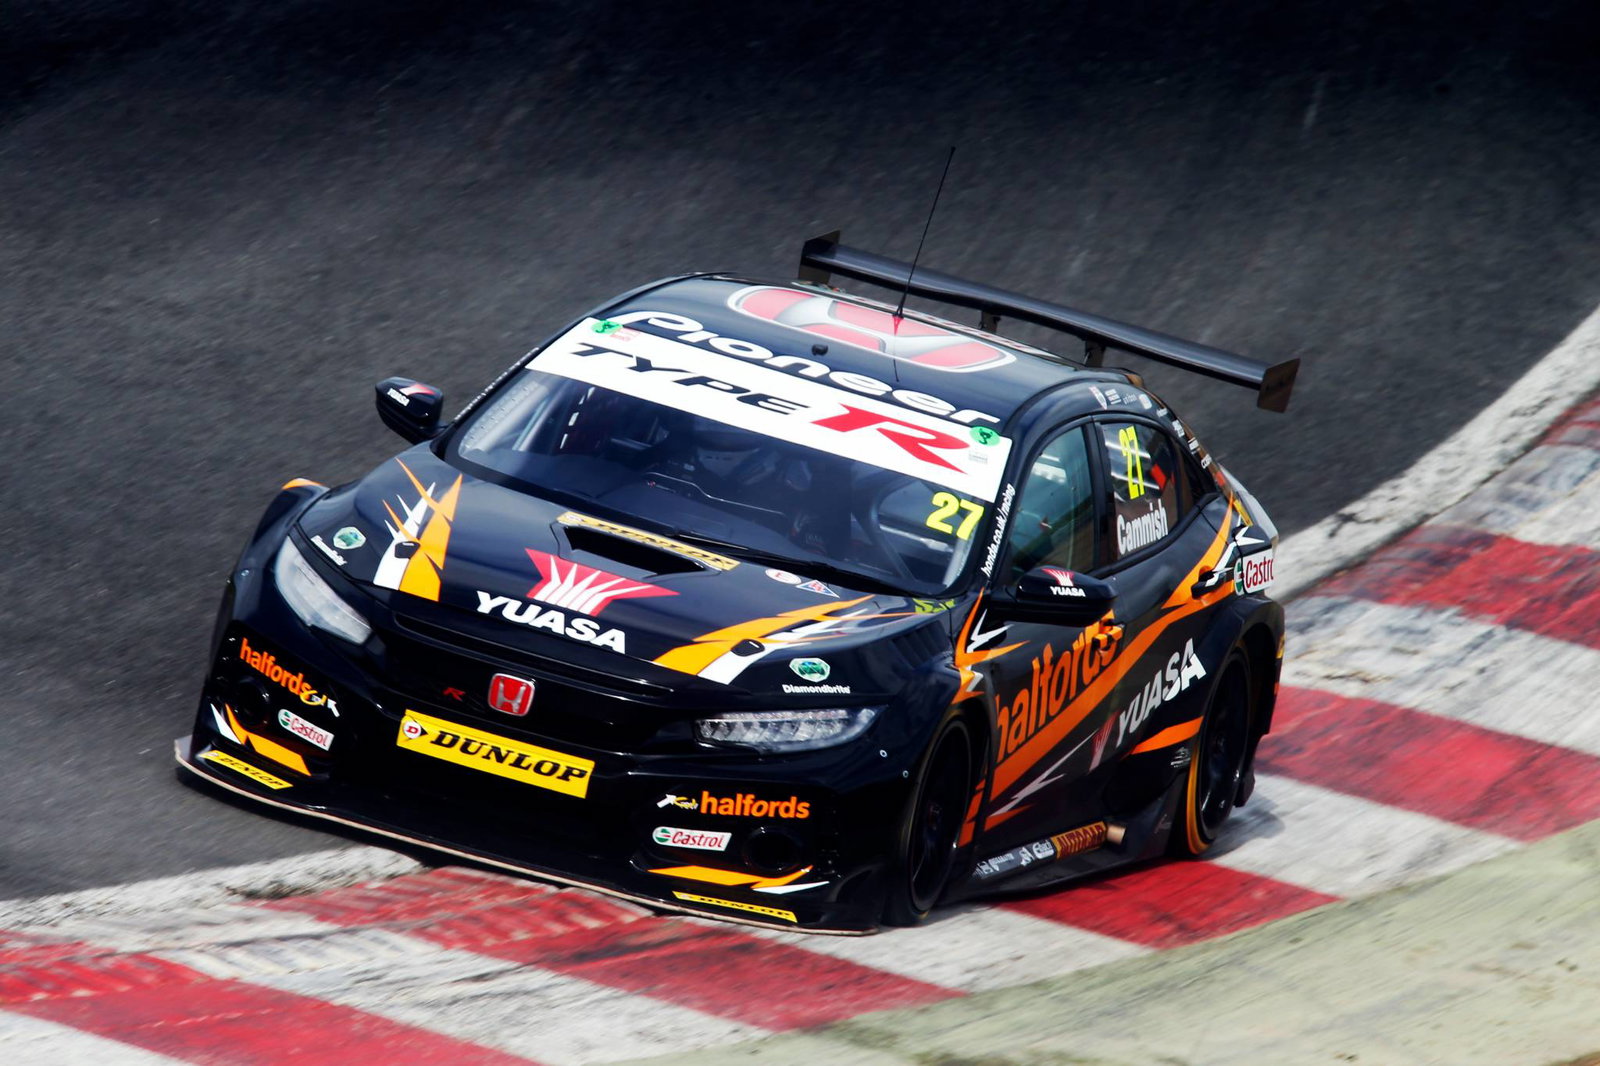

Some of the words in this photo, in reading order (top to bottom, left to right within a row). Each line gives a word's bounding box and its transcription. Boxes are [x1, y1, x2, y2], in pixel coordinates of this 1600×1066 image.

[609, 310, 1001, 424] Pioneer
[570, 342, 814, 416] TYPE
[810, 402, 970, 475] R
[1118, 425, 1145, 499] 27
[926, 492, 984, 540] 27
[980, 483, 1016, 578] honda.co.uk/racing
[1117, 498, 1169, 554] Cammish
[1050, 586, 1086, 597] YUASA
[477, 590, 626, 654] YUASA
[240, 637, 312, 701] halfords
[782, 684, 850, 694] Diamondbrite
[1116, 638, 1207, 748] YUASA
[291, 718, 329, 747] Castrol
[430, 730, 588, 781] DUNLOP
[700, 790, 811, 819] halfords
[671, 832, 724, 848] Castrol
